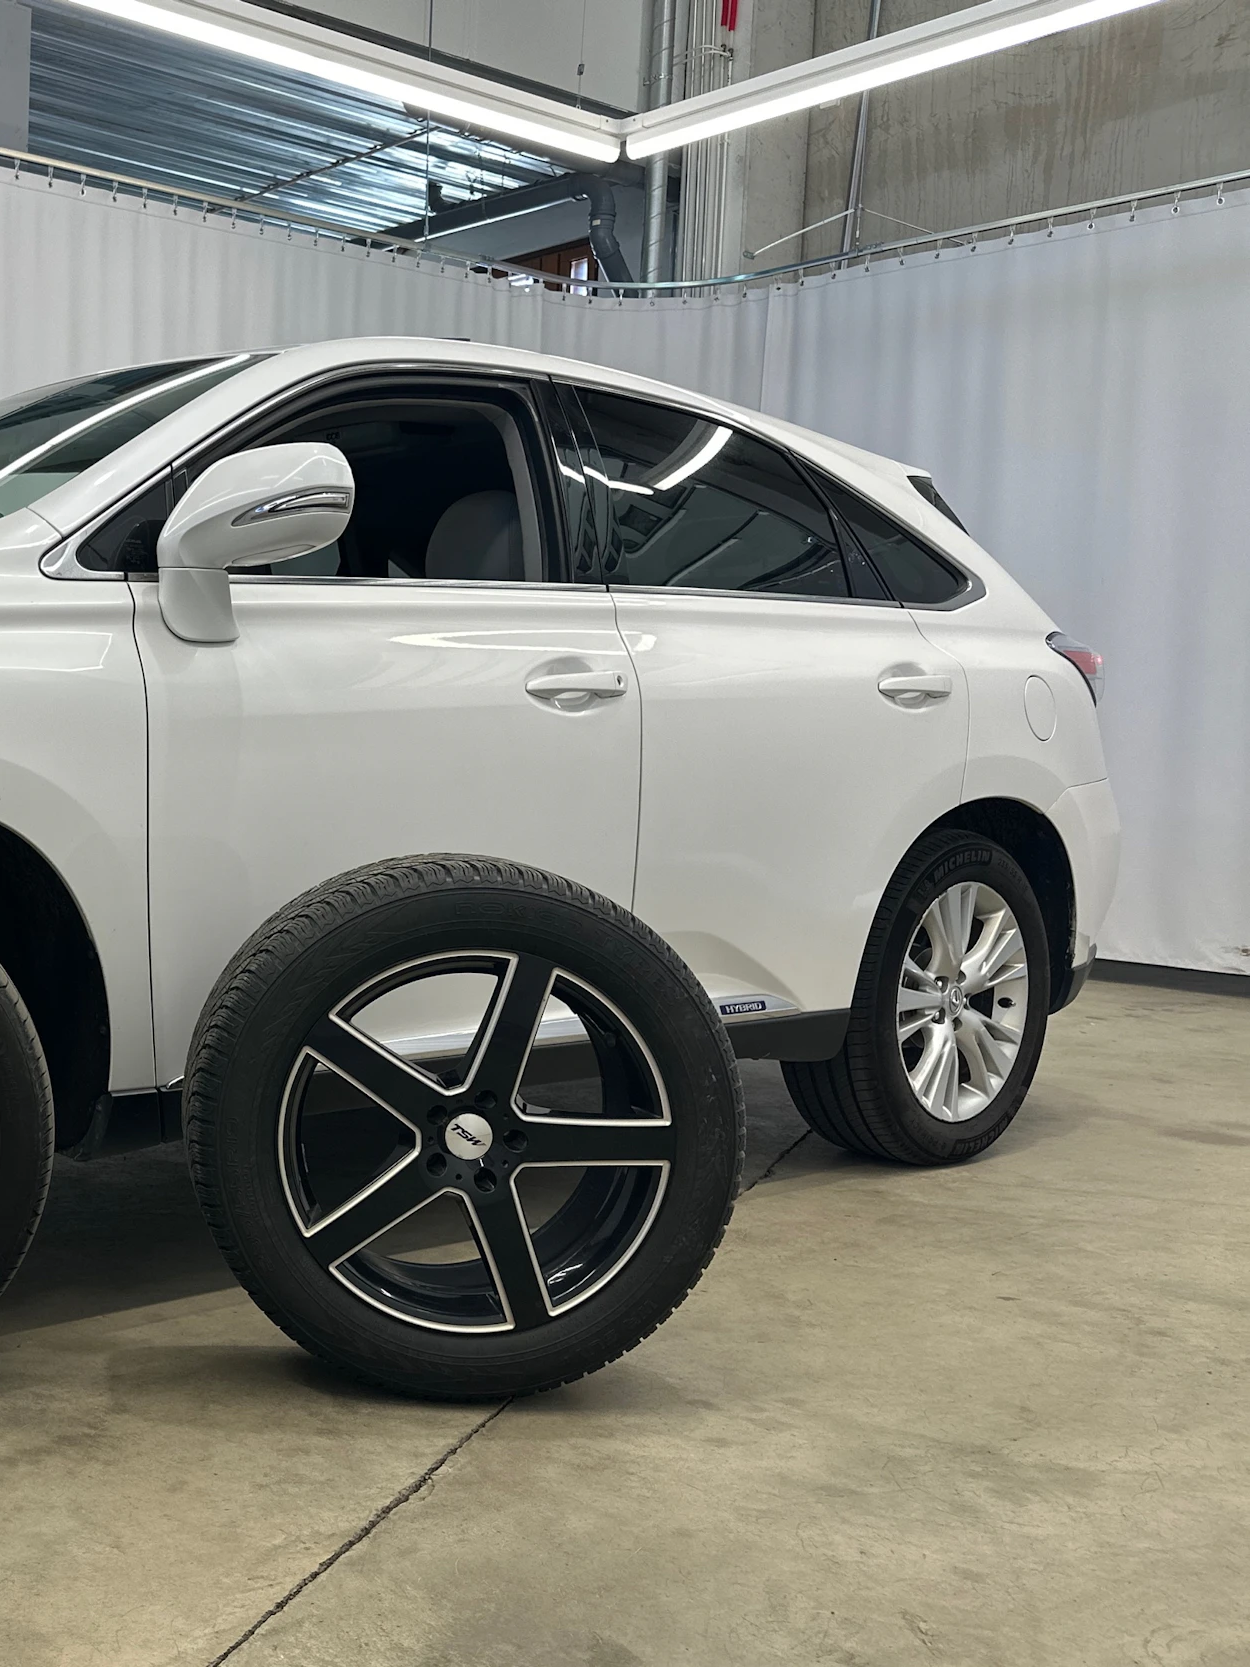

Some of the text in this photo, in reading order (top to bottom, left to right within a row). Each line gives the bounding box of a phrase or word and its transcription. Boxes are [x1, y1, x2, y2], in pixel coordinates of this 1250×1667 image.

[933, 850, 991, 882] MICHELIN
[725, 1002, 762, 1014] HYBRID
[451, 1123, 487, 1146] TSW
